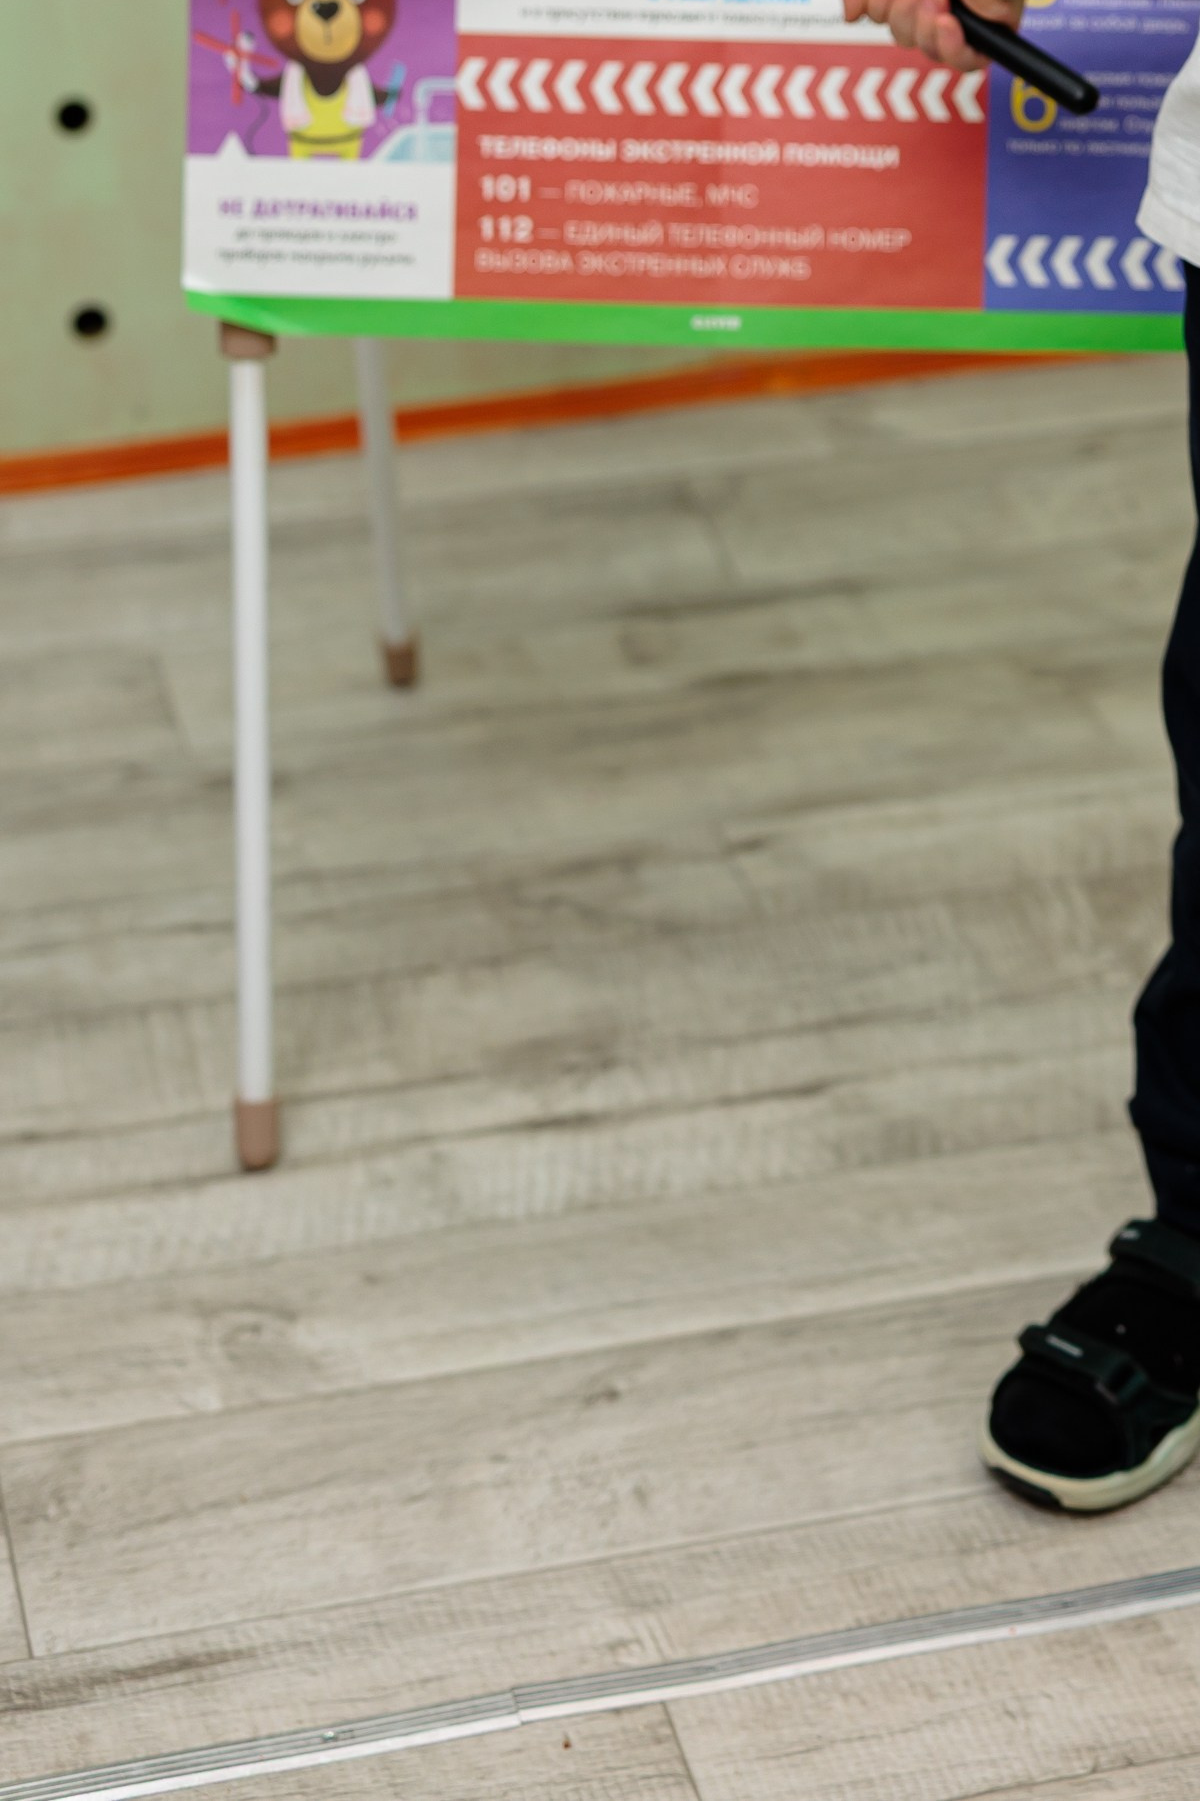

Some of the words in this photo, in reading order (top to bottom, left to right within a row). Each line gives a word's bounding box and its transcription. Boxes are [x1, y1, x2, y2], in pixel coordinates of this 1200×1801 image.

[1010, 71, 1058, 133] 6
[478, 134, 616, 161] ТЕЛЕФОНЫ
[621, 138, 779, 166] ЭКСТРЕННОЙ
[783, 142, 900, 171] ПОМОЩИ
[479, 175, 532, 202] 101
[564, 180, 702, 208] ПОЖАРНЫЕ,
[706, 184, 759, 209] МЧС
[217, 198, 245, 217] НЕ
[249, 197, 420, 223] ДОТРАГИВАЙСЯ
[478, 215, 533, 243] 112
[564, 220, 664, 246] ЕДИНЫЙ
[667, 223, 824, 250] ТЕЛЕФОННЫЙ
[827, 228, 911, 253] НОМЕР
[474, 250, 575, 275] ВЫЗОВА
[577, 251, 727, 279] ЭКСТРЕННЫХ
[730, 253, 811, 280] СЛУЖБ
